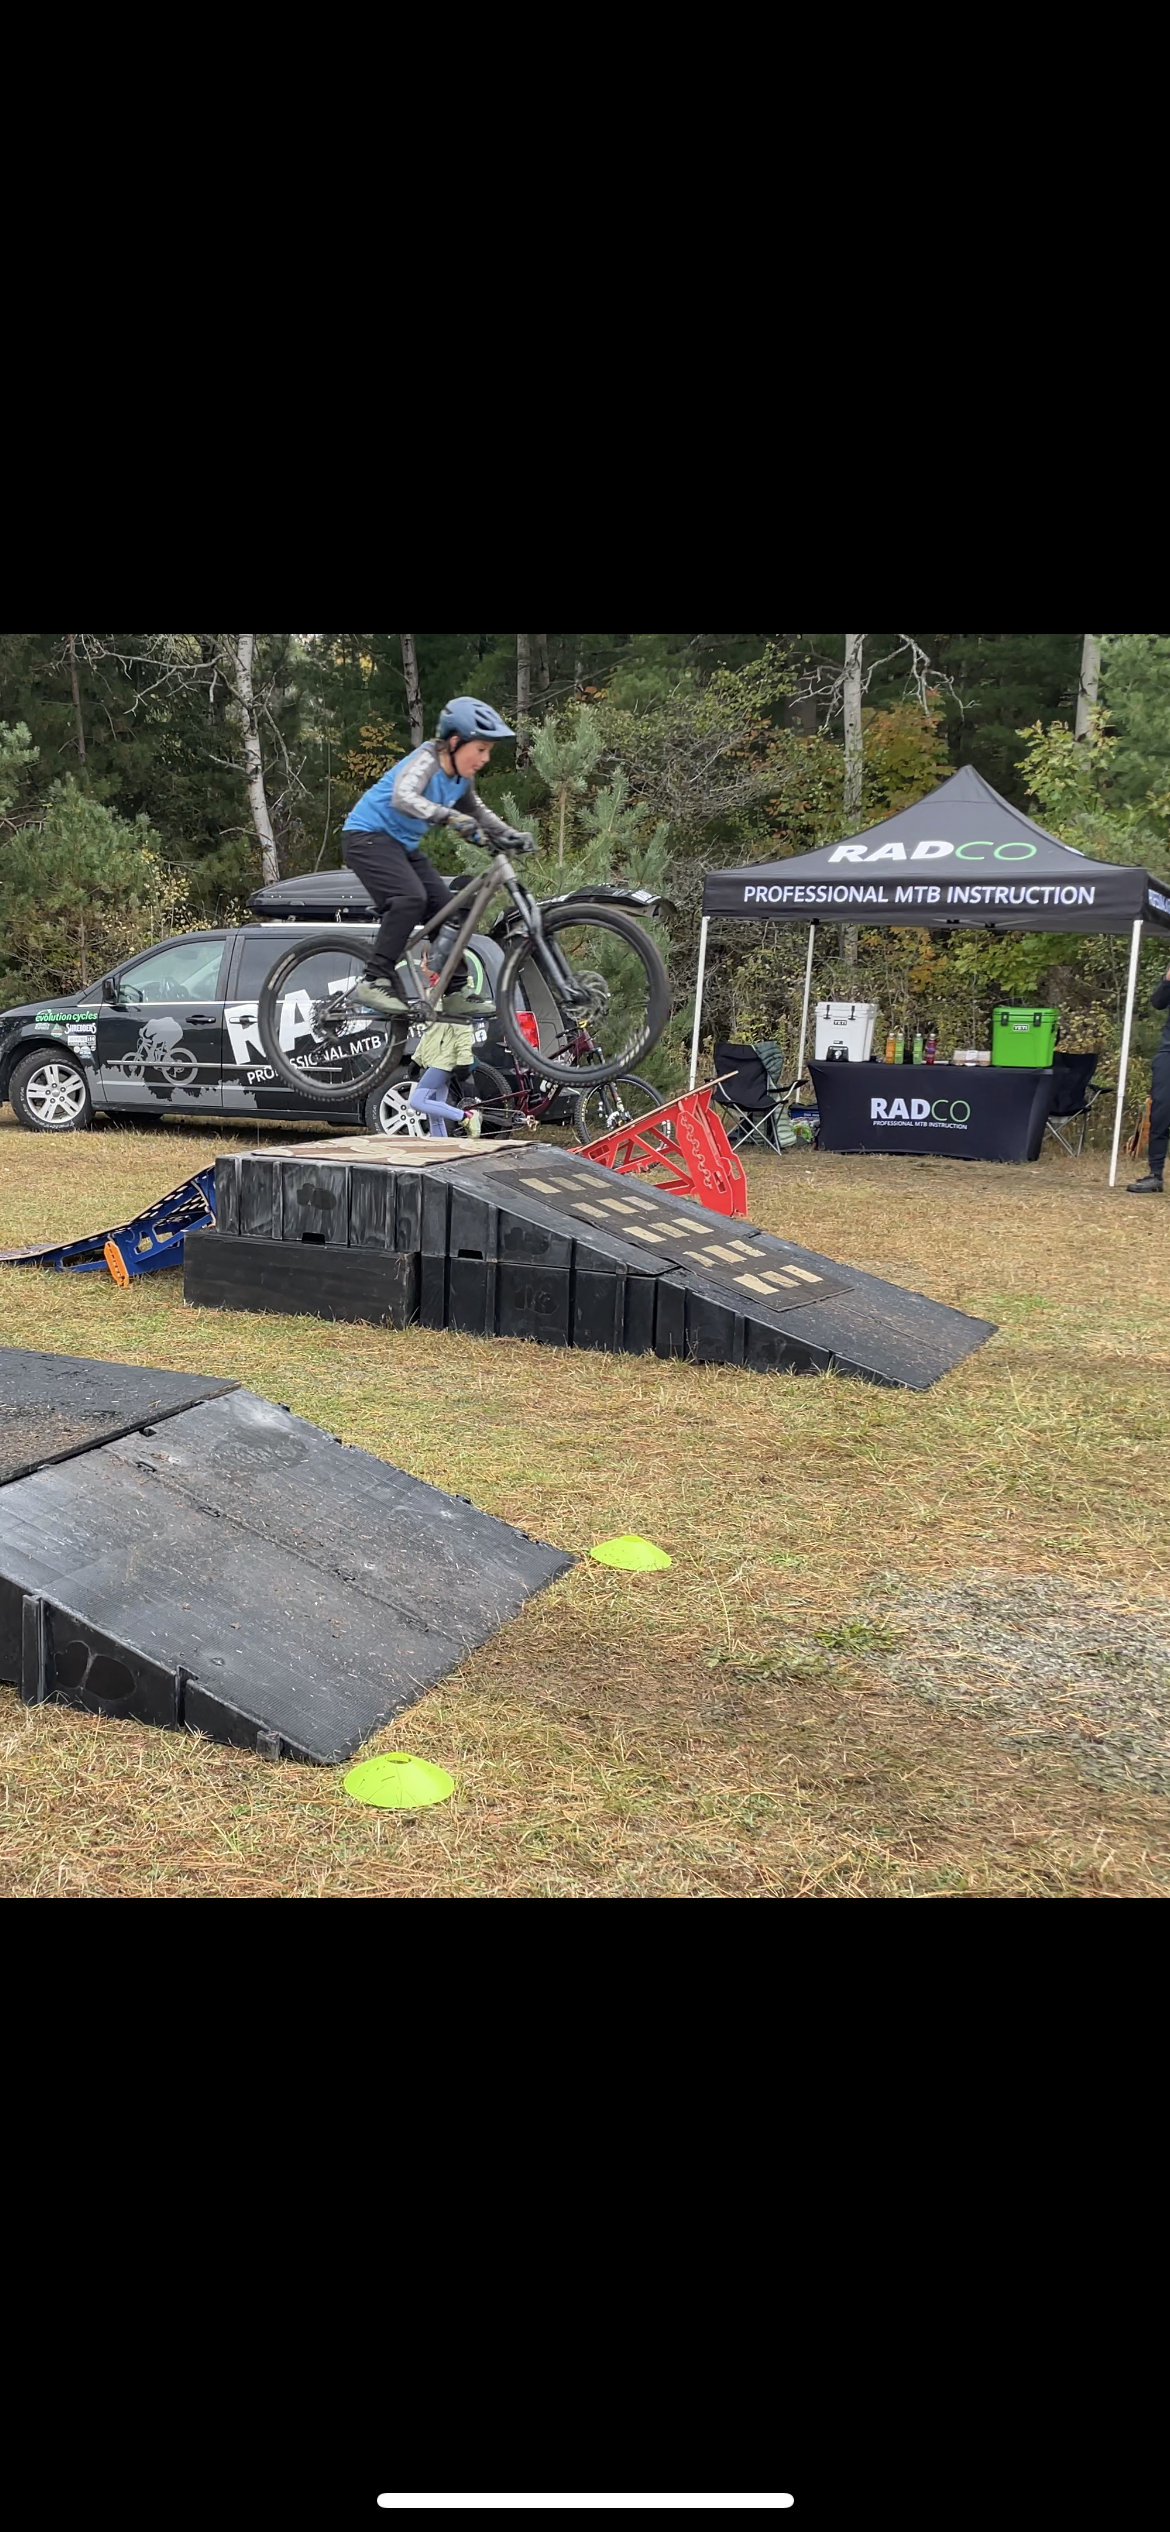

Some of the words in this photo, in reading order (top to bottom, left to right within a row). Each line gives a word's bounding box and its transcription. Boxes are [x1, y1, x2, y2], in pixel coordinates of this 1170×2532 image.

[828, 841, 1037, 863] RADCO
[743, 885, 889, 903] PROFESSIONAL
[894, 885, 941, 903] MTB
[946, 885, 1096, 905] INSTRUCTION
[35, 1012, 72, 1022] evolution
[72, 1011, 98, 1023] cycles
[350, 1034, 382, 1055] MTB
[870, 1098, 971, 1122] RADCO
